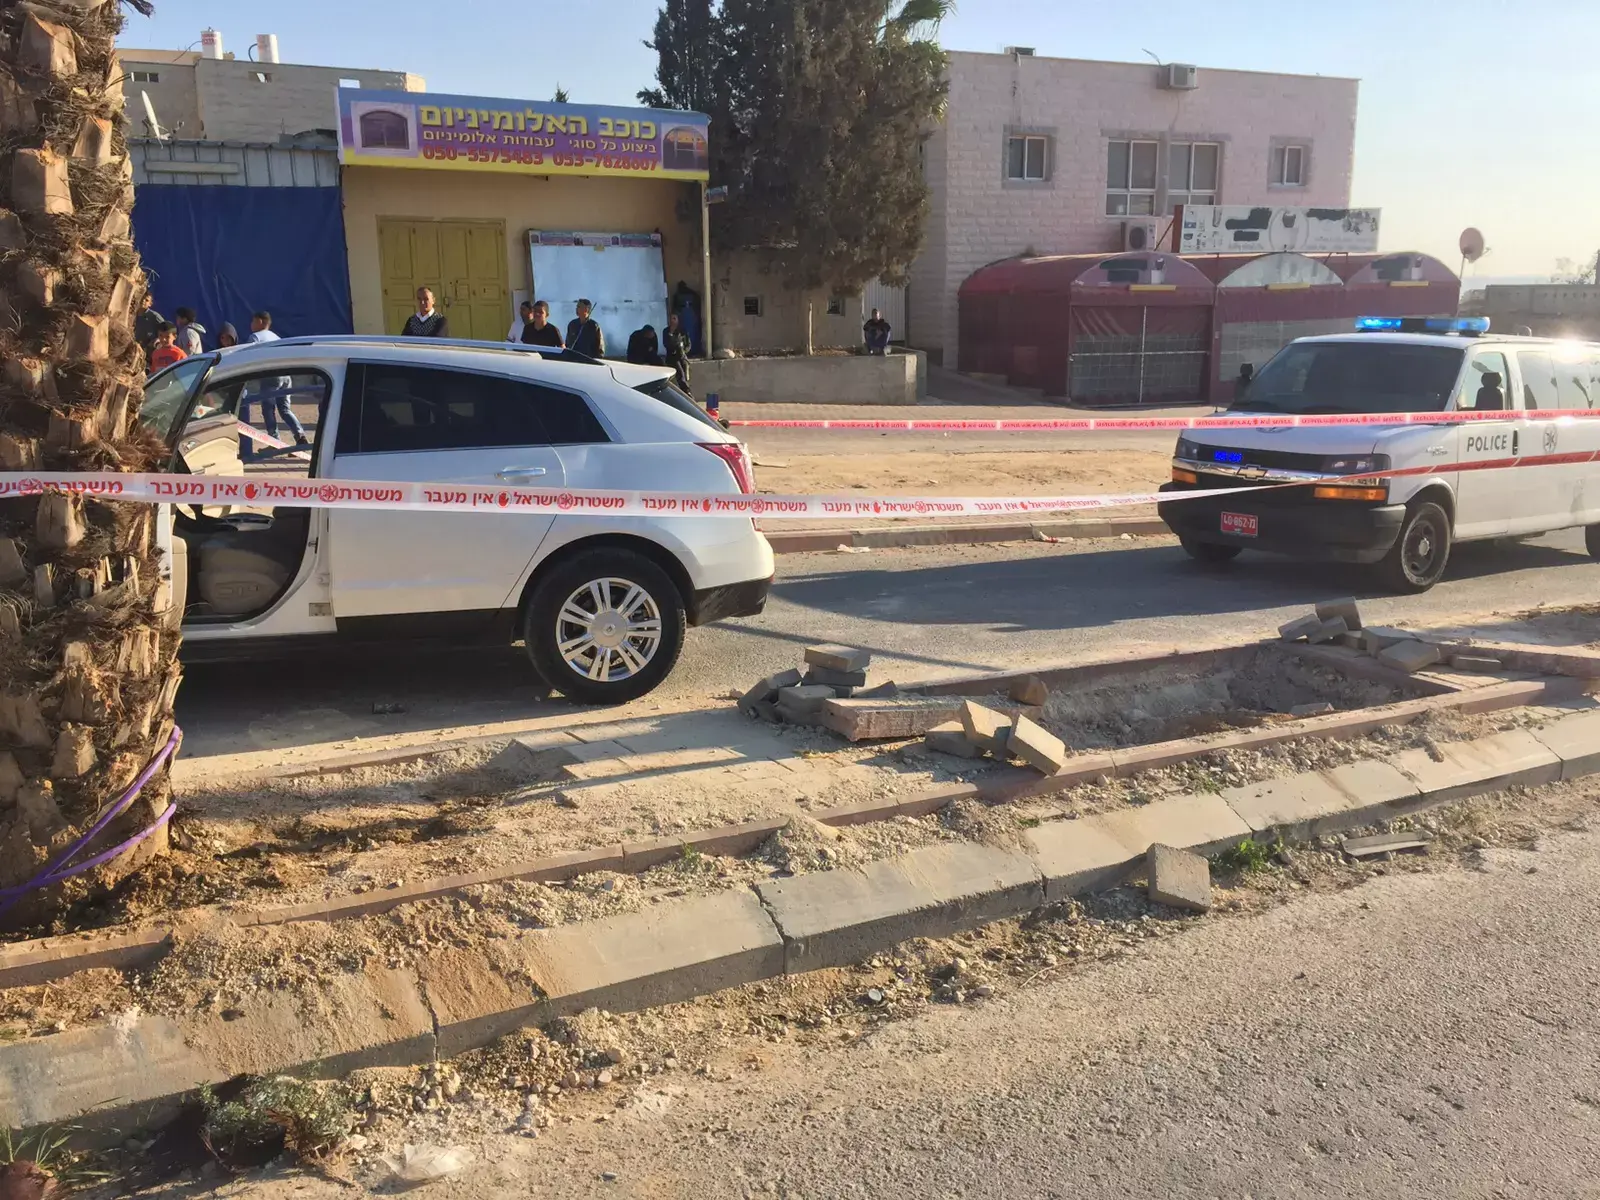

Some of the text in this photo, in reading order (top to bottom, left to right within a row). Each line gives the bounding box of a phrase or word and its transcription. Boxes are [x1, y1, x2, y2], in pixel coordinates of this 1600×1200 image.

[419, 105, 657, 140] כוכב האלומיניום
[423, 130, 657, 154] ביצוע כל סוגי עבודות אלומיניום
[1467, 435, 1507, 452] POLICE
[150, 480, 403, 502] משטרת ישראל אין מעבר
[424, 490, 625, 509] משטרת ישראל אין מעבר
[642, 497, 808, 512] משטרת ישראל אין מעבר
[821, 500, 964, 514] משטרת ישראל אין מעבר
